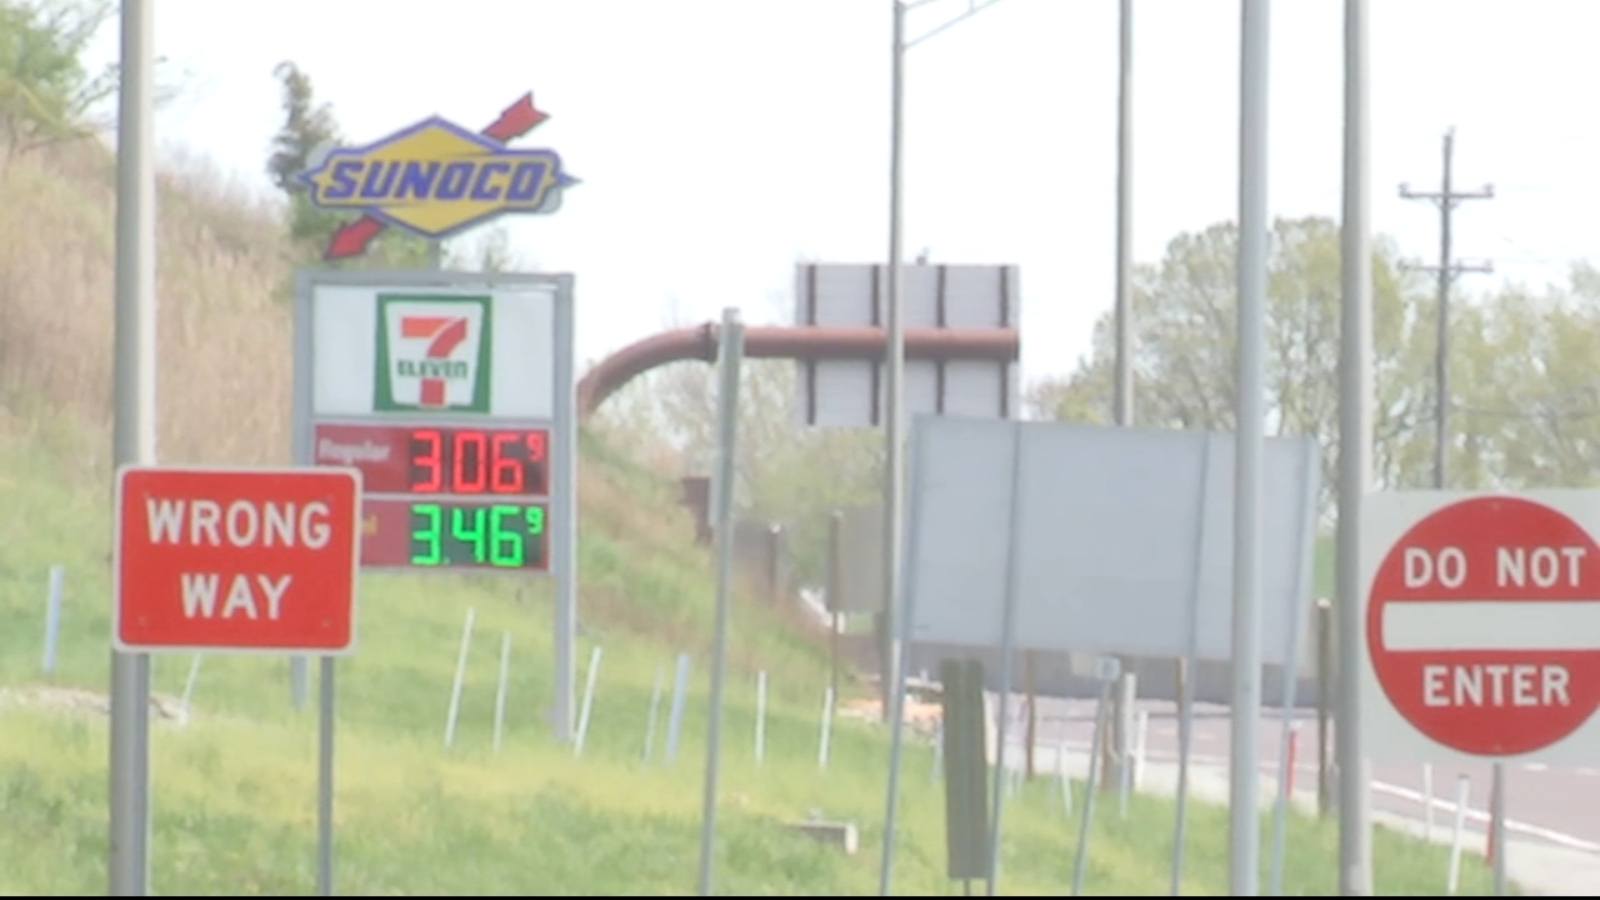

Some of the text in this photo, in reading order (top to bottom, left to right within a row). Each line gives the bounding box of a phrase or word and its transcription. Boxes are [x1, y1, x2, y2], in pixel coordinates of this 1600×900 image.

[324, 160, 547, 201] SUNOCO
[401, 316, 468, 406] 7
[145, 498, 332, 550] WRONG
[1403, 546, 1587, 588] DO NOT
[180, 572, 293, 620] WAY
[1423, 664, 1571, 707] ENTER
